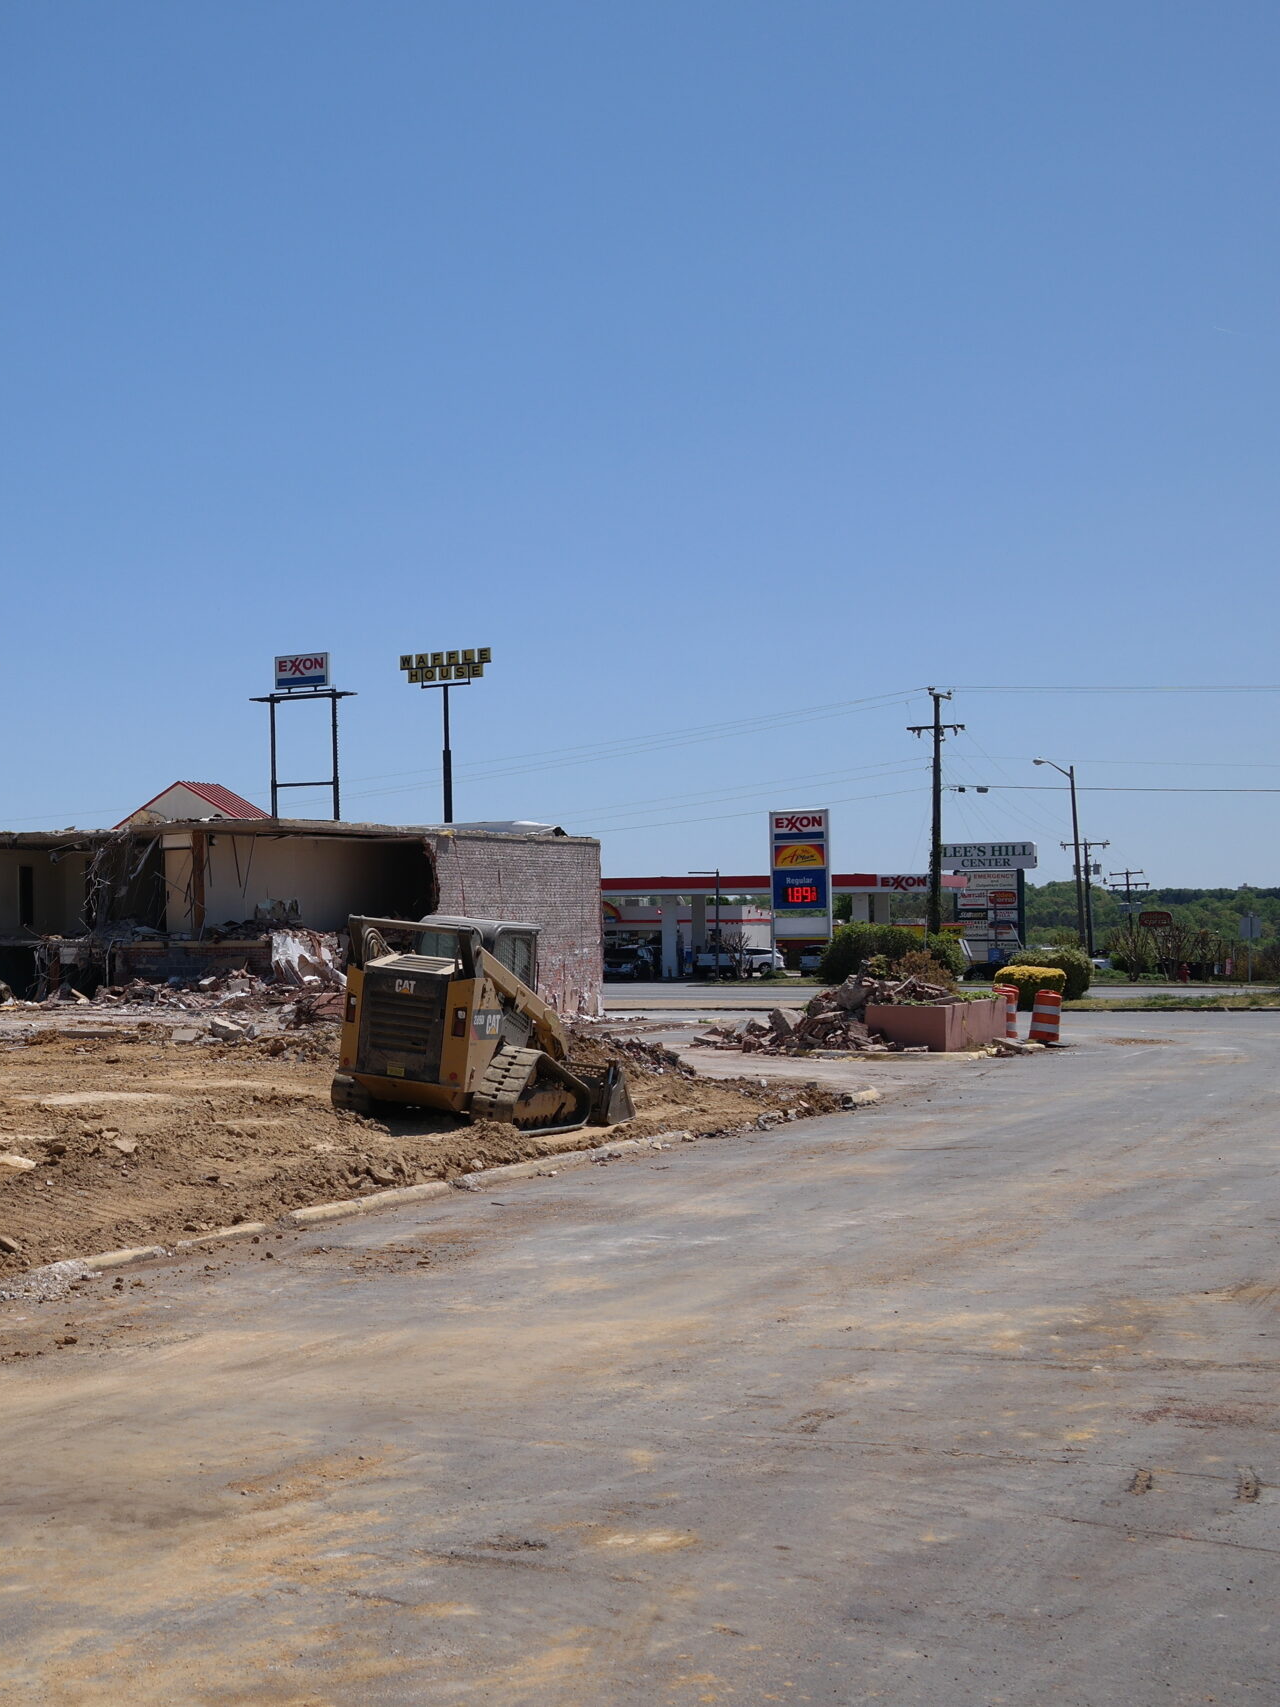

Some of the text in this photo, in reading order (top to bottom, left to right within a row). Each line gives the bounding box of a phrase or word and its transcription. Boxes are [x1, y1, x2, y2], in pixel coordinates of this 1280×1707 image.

[278, 656, 324, 676] EXXON
[401, 649, 488, 667] WAFFLE
[410, 665, 481, 681] HOUSE
[775, 815, 822, 832] EXXON
[943, 844, 1032, 858] LEE'S HILL
[961, 857, 1012, 868] CENTER
[786, 877, 813, 886] Regular
[880, 875, 927, 891] EXXON
[395, 979, 416, 994] CAT
[486, 1014, 501, 1035] CAT
